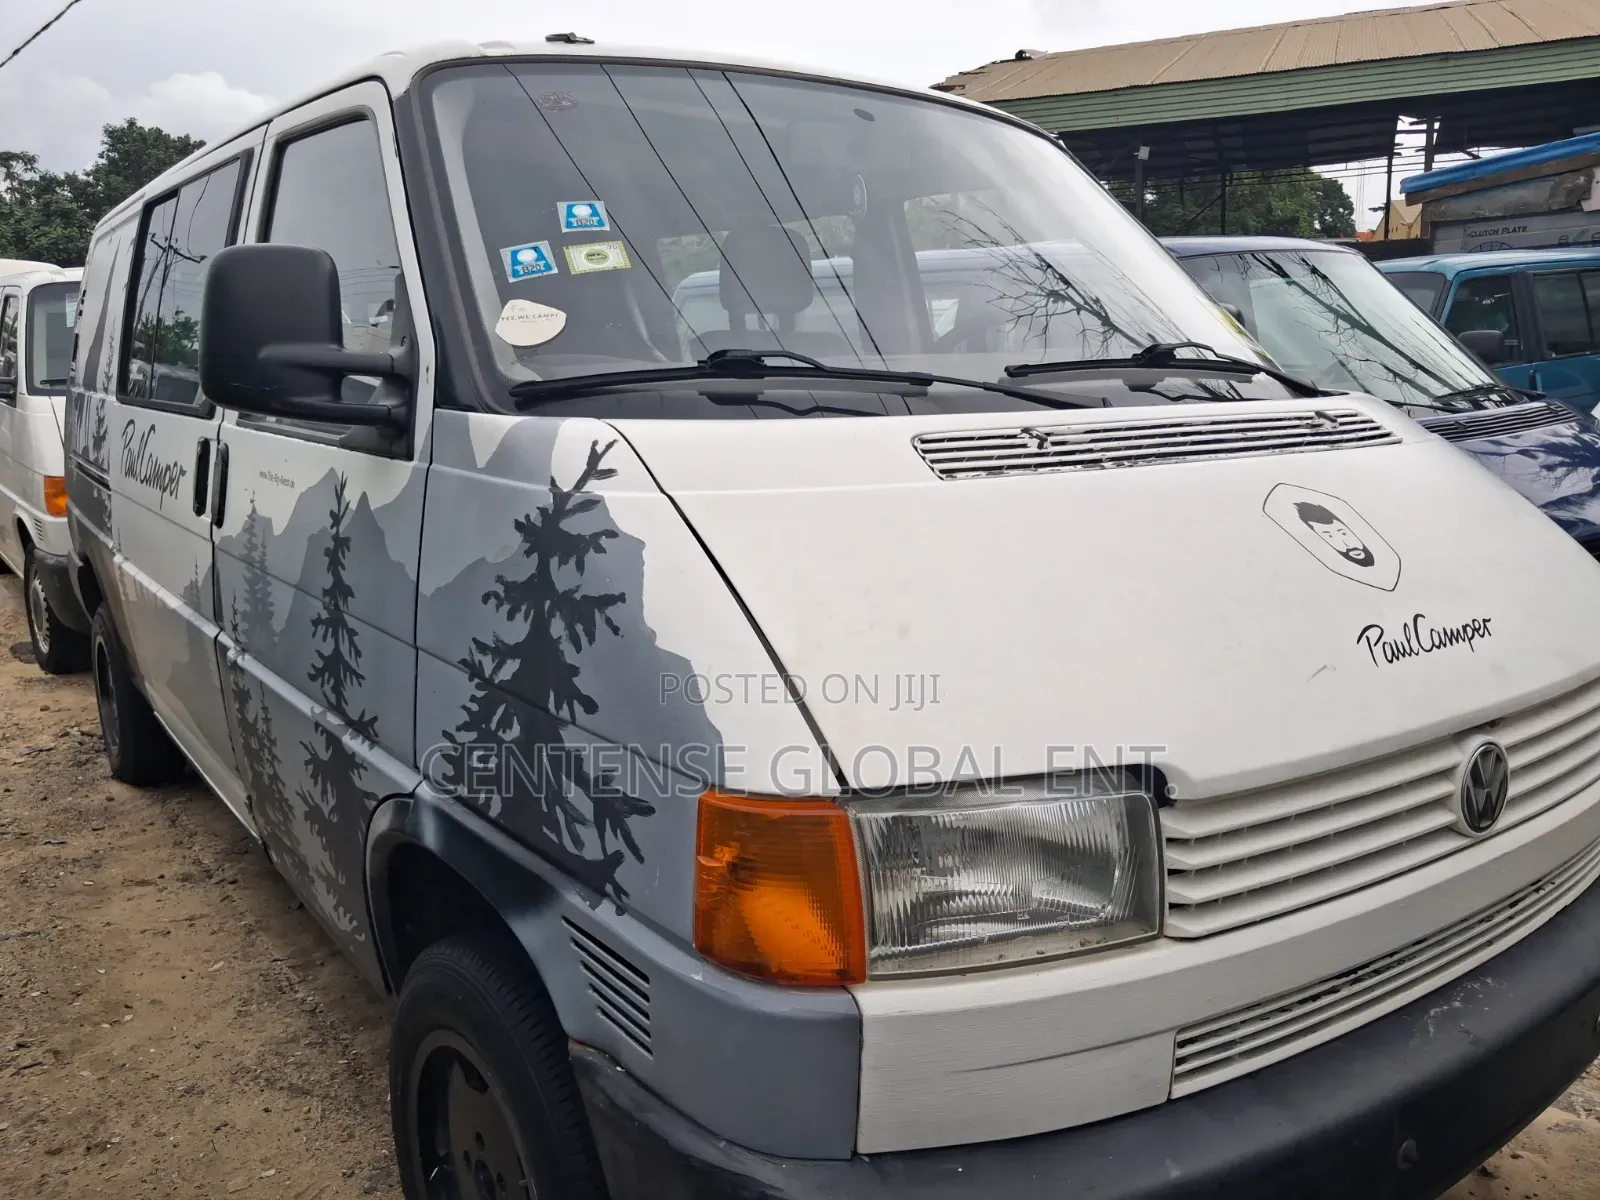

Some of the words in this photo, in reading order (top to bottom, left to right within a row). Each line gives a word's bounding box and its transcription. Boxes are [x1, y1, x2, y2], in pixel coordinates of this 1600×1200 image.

[1469, 229, 1500, 238] CLUTCH
[1501, 225, 1529, 235] PLATE
[521, 263, 542, 274] B20
